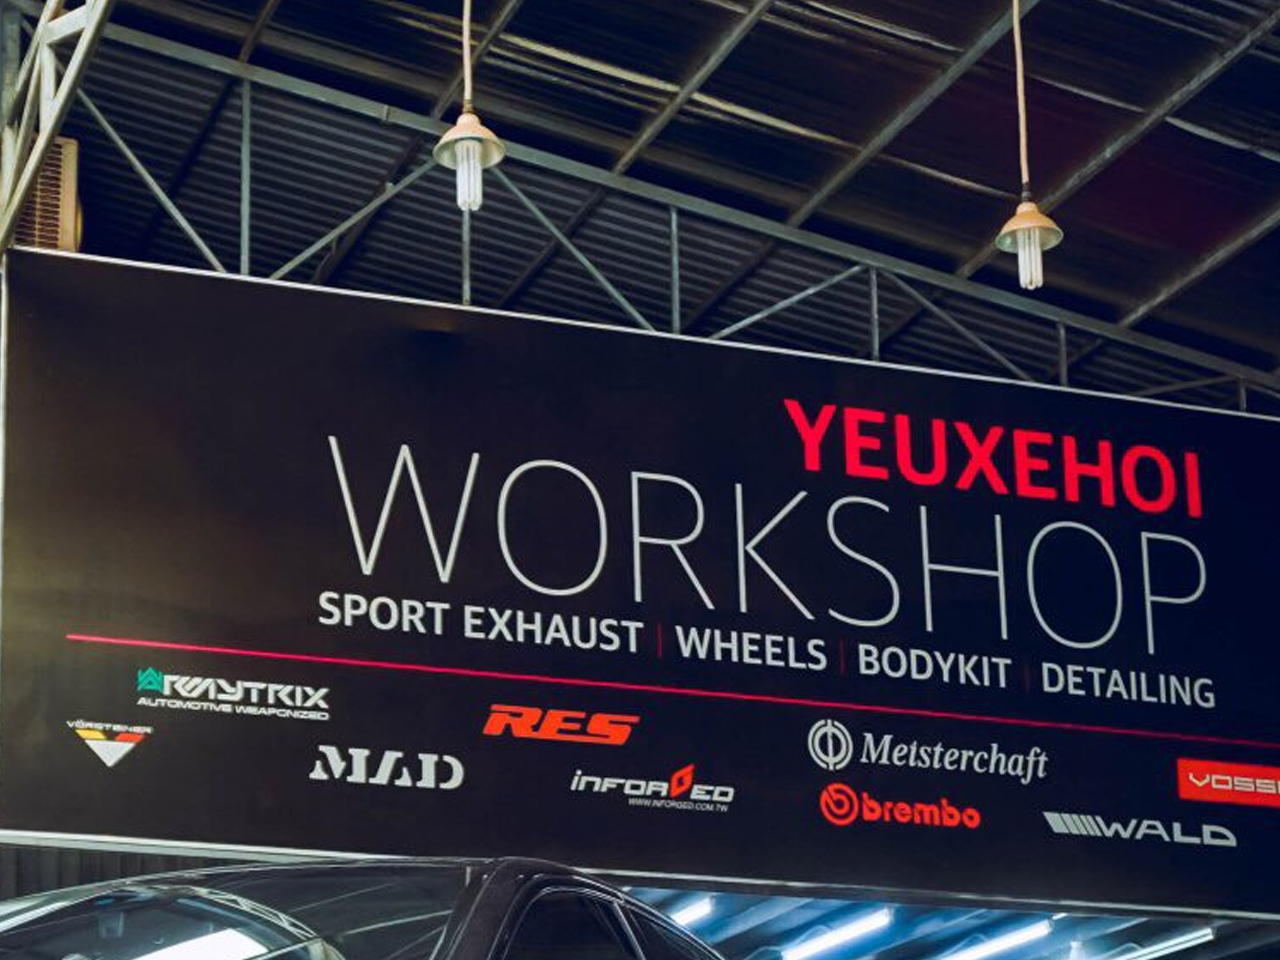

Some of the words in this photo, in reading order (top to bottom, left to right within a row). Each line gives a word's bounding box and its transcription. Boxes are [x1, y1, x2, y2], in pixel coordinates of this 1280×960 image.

[784, 399, 1203, 517] YEUXEHOI
[328, 435, 1208, 654] WORKSHOP
[318, 590, 450, 636] SPORT
[463, 604, 645, 653] EXHAUST
[675, 625, 828, 670] WHEELS
[858, 644, 1012, 688] BODYKIT
[1041, 662, 1216, 708] DETAILING
[137, 696, 232, 713] AUTOMOTIVE
[235, 705, 329, 721] WEAPONIZED
[483, 704, 640, 746] RES
[309, 745, 465, 790] MAD
[860, 732, 1049, 785] Meisterchaft
[1188, 772, 1280, 795] VOSS
[862, 791, 981, 828] brembo
[1094, 815, 1238, 847] WALD
